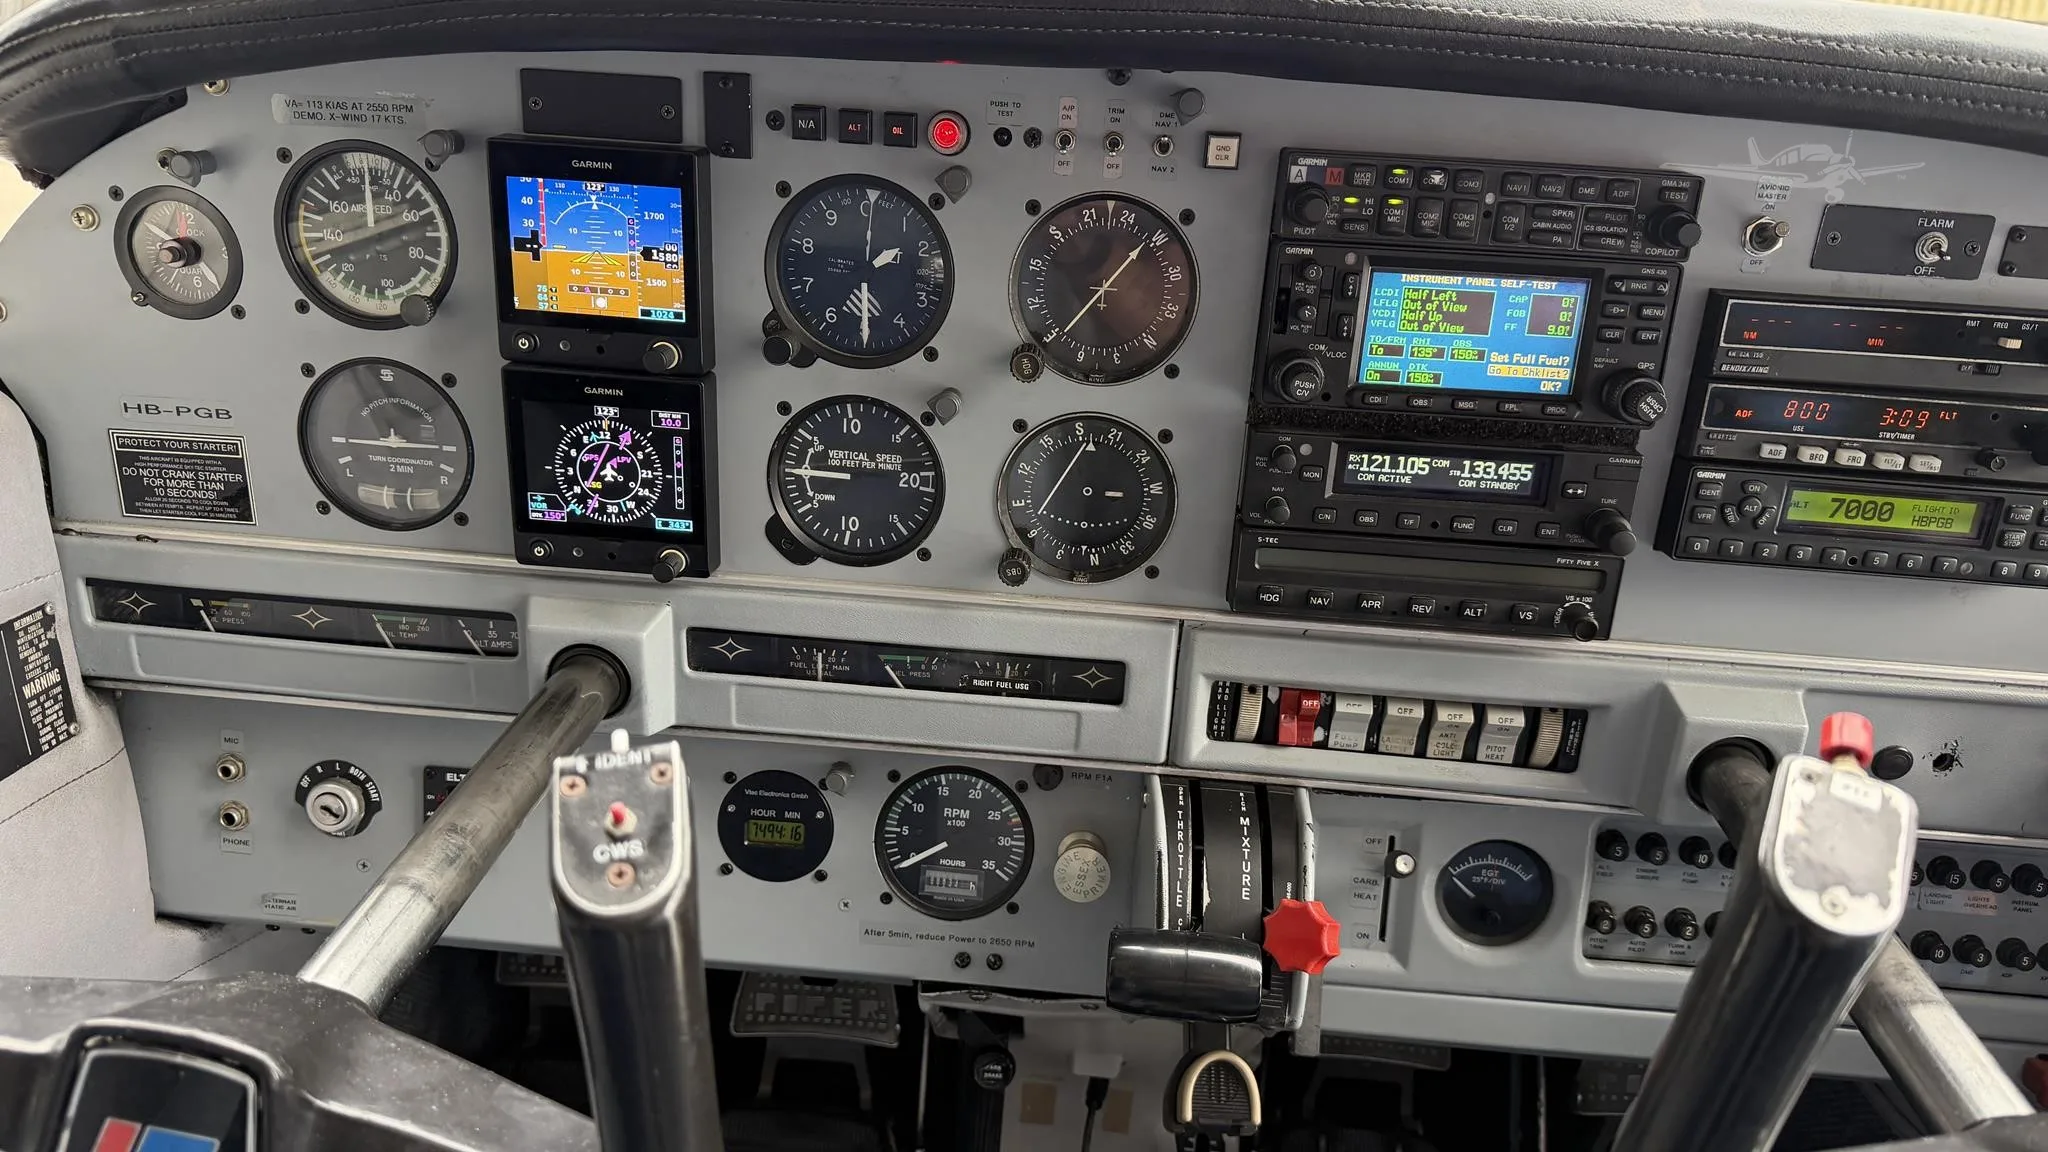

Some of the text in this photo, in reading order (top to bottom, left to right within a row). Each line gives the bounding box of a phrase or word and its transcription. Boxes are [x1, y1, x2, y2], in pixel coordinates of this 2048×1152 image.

[285, 100, 414, 113] VA= 113 KIAS AT 2550 RPM
[294, 111, 325, 120] DEMO.
[330, 113, 367, 122] X-WIND
[385, 115, 407, 124] KTS.
[798, 120, 815, 129] N/A
[892, 126, 903, 134] OIL
[572, 160, 612, 170] GARMIN
[1298, 158, 1327, 166] GARMIN
[1388, 176, 1409, 185] COM1
[1507, 184, 1527, 192] NAV1
[1541, 185, 1561, 193] NAV2
[1758, 192, 1787, 201] MASTER
[330, 201, 348, 213] 160
[403, 210, 419, 222] 60
[644, 212, 664, 220] 1700
[1552, 210, 1574, 218] SPKR
[1918, 218, 1954, 229] FLARM
[323, 230, 343, 241] 140
[1293, 227, 1316, 235] PILOT
[409, 247, 423, 259] 80
[1645, 248, 1680, 256] COPILOT
[1914, 266, 1936, 277] OFF
[647, 279, 666, 287] 1500
[1401, 275, 1557, 290] INSTRUMENT PANEL SELF-TEST
[1404, 289, 1457, 301] Half Left
[1403, 299, 1467, 312] Out of View
[650, 310, 674, 319] 1024
[1401, 310, 1443, 322] Half Up
[1643, 308, 1664, 316] MENU
[1743, 331, 1757, 340] NM
[1867, 338, 1884, 346] MIN
[1490, 352, 1570, 366] Set Full Fuel?
[1719, 363, 1770, 374] BENDIX/KING
[1295, 381, 1315, 389] PUSH
[1540, 381, 1562, 391] OK?
[584, 387, 623, 396] GARMIN
[1296, 389, 1309, 397] C/V
[123, 402, 233, 419] HB-PGB
[1784, 401, 1830, 421] 800
[1940, 411, 1958, 420] FLT
[661, 419, 681, 427] 10.0
[1880, 408, 1929, 429] 3:09
[843, 418, 861, 434] 10
[1878, 432, 1915, 440] STBY/TIMER
[119, 438, 236, 452] PROTECT YOUR STARTER!
[387, 457, 434, 466] COORDINATOR
[828, 449, 902, 463] VERTICAL SPEED
[1809, 453, 1824, 461] BFO
[842, 460, 863, 468] FEET
[865, 461, 876, 469] PER
[878, 462, 902, 471] MINUTE
[1360, 454, 1431, 475] 121.105
[122, 467, 243, 482] DO NOT CRANK STARTER
[1461, 460, 1534, 481] 133.455
[899, 472, 920, 488] 20
[1358, 473, 1412, 483] COM ACTIVE
[143, 478, 224, 490] FOR MORE THAN
[1458, 479, 1520, 491] COM STANDBY
[154, 488, 217, 499] 10 SECONDS!
[1828, 498, 1895, 522] 7000
[1912, 504, 1945, 513] FLIGHT
[1912, 515, 1953, 528] HBPGB
[1259, 592, 1280, 603] HDG
[1309, 595, 1330, 606] NAV
[1361, 599, 1381, 609] APR
[1411, 603, 1432, 614] REV
[1463, 607, 1482, 617] ALT
[1519, 610, 1533, 620] VS
[23, 669, 61, 700] WARNING
[973, 679, 993, 687] RIGHT
[996, 681, 1012, 689] FUEL
[224, 736, 239, 744] MIC
[1486, 744, 1507, 753] PITOT
[1485, 753, 1504, 761] HEAT
[350, 766, 366, 781] BOTH
[365, 782, 380, 801] START
[751, 809, 800, 819] HOUR MIN
[944, 808, 970, 819] RPM
[223, 838, 250, 847] PHONE
[593, 839, 644, 864] CWS
[940, 858, 966, 867] HOURS
[1176, 810, 1184, 908] THROTTLE
[1240, 816, 1251, 901] MIXTURE
[1073, 859, 1091, 896] ESSEX
[1481, 869, 1499, 877] EGT
[888, 930, 912, 940] 5min,
[916, 933, 945, 941] reduce
[949, 935, 975, 943] Power
[989, 938, 1012, 946] 2650
[1015, 940, 1035, 948] RPM
